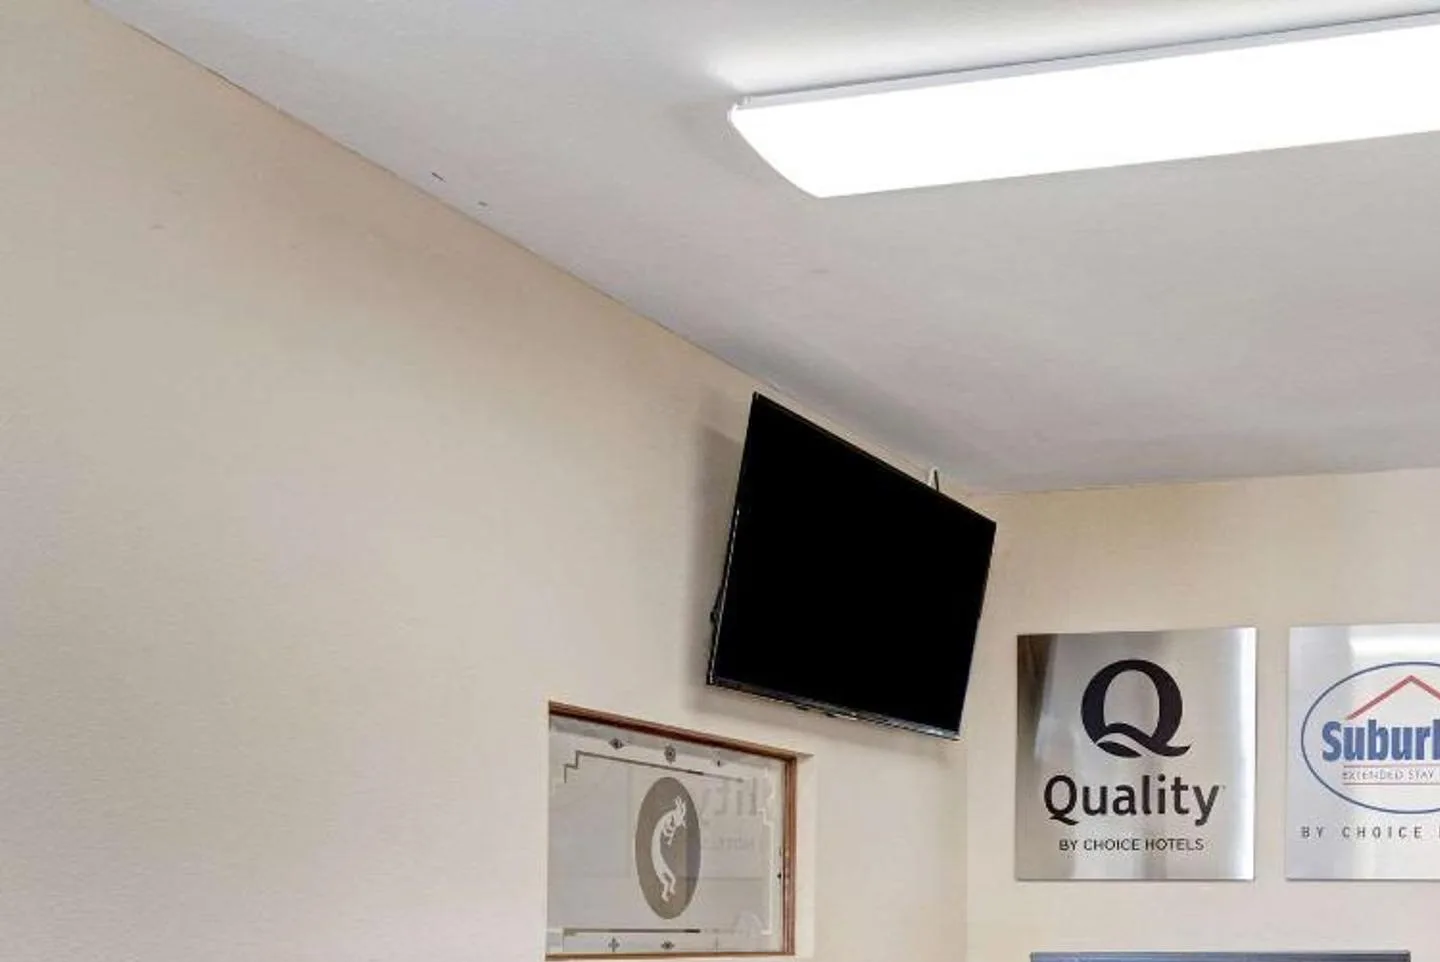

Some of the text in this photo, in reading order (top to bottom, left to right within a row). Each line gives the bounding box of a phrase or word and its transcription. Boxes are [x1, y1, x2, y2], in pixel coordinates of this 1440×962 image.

[1081, 659, 1192, 758] Q
[1342, 768, 1404, 781] EXTENDED
[1408, 768, 1434, 780] STAY
[1044, 774, 1220, 826] Quality
[1301, 826, 1325, 839] BY
[1341, 826, 1422, 840] CHOICE
[1059, 837, 1205, 851] BY CHOICE HOTELS
